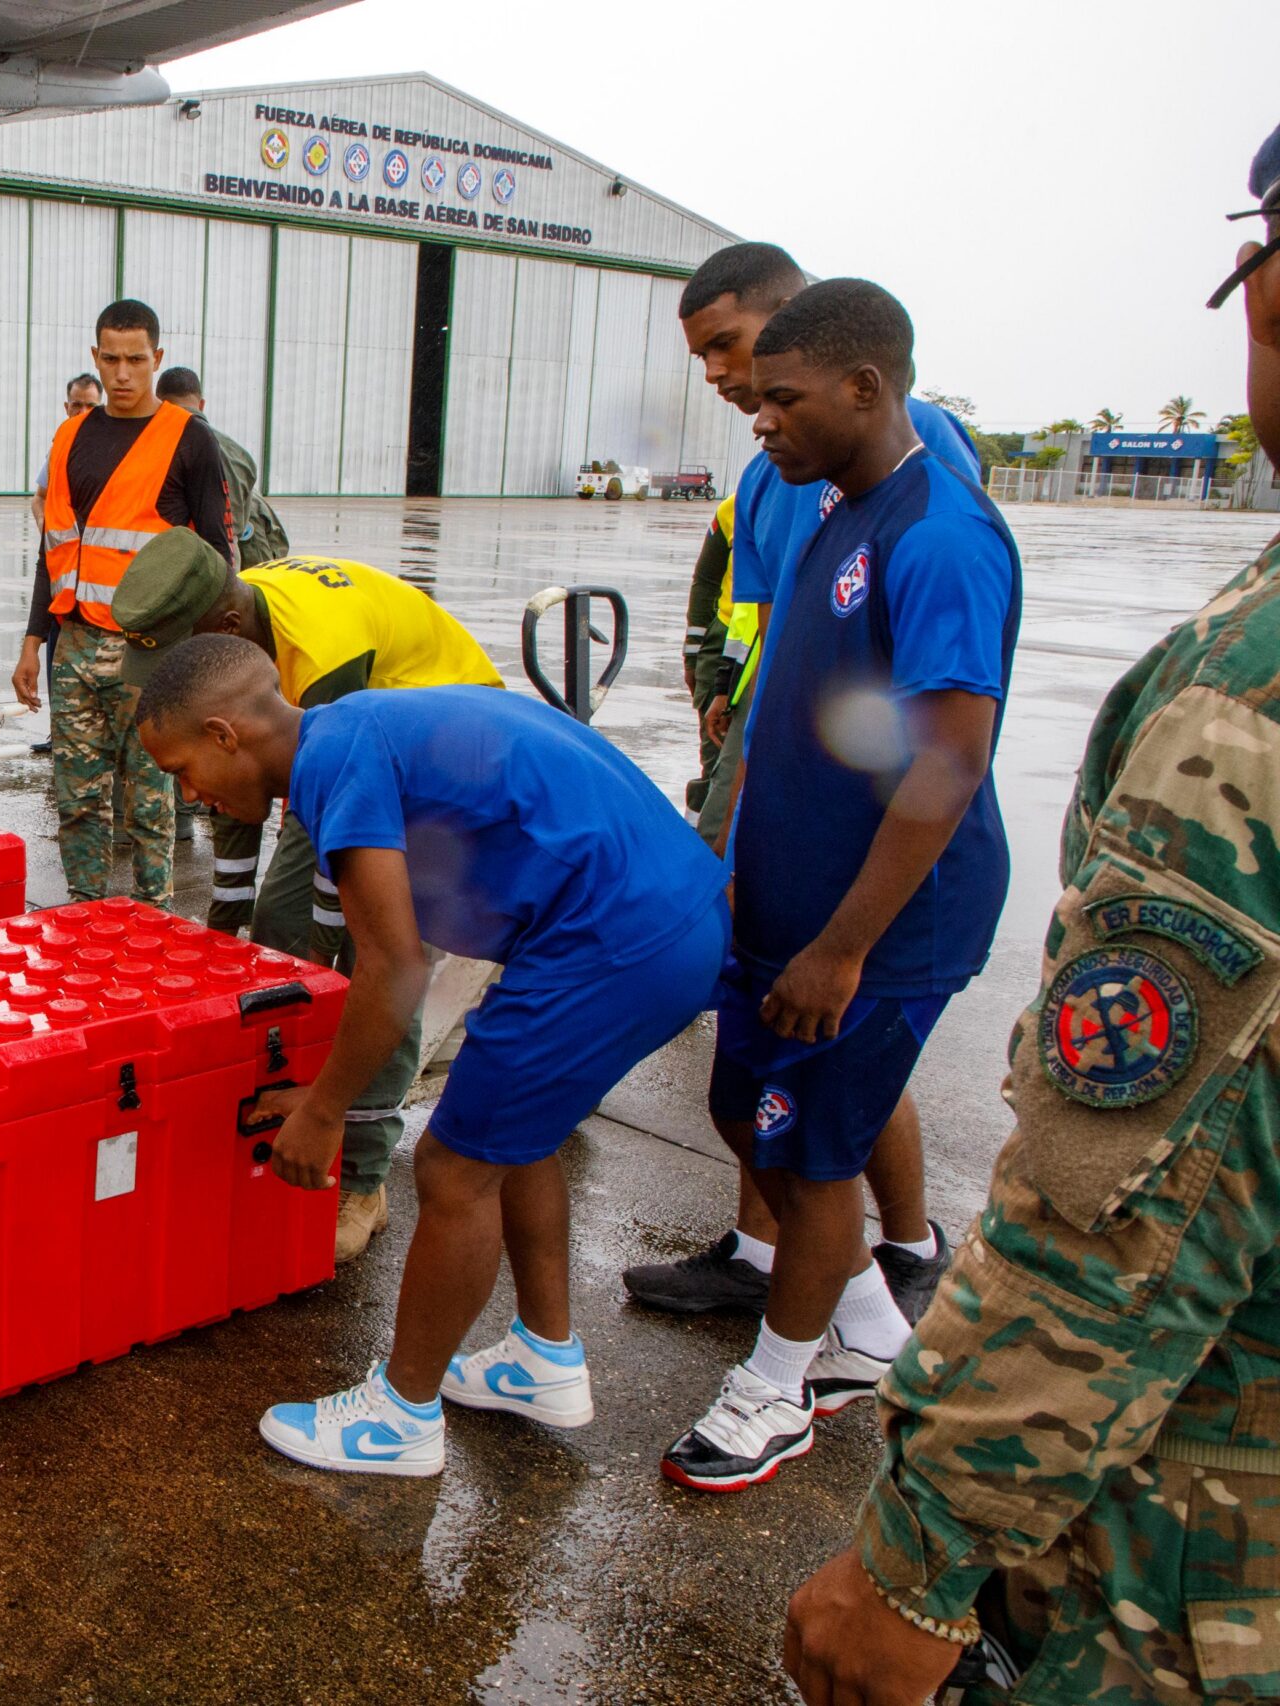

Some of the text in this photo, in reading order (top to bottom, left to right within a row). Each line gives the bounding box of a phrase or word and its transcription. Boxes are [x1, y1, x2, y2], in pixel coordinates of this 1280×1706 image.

[255, 104, 553, 171] FUERZA AÉREA DE REPÚBLICA DOMINICANA
[206, 173, 592, 246] BIENVENIDO A LA BASE AÉREA DE SAN ISIDRO
[1121, 441, 1168, 449] SALON VIP
[1051, 953, 1110, 1005] COMANDO
[1119, 951, 1185, 1006] SEGURIDAD
[1174, 1012, 1190, 1031] DE
[1083, 1082, 1099, 1099] DE
